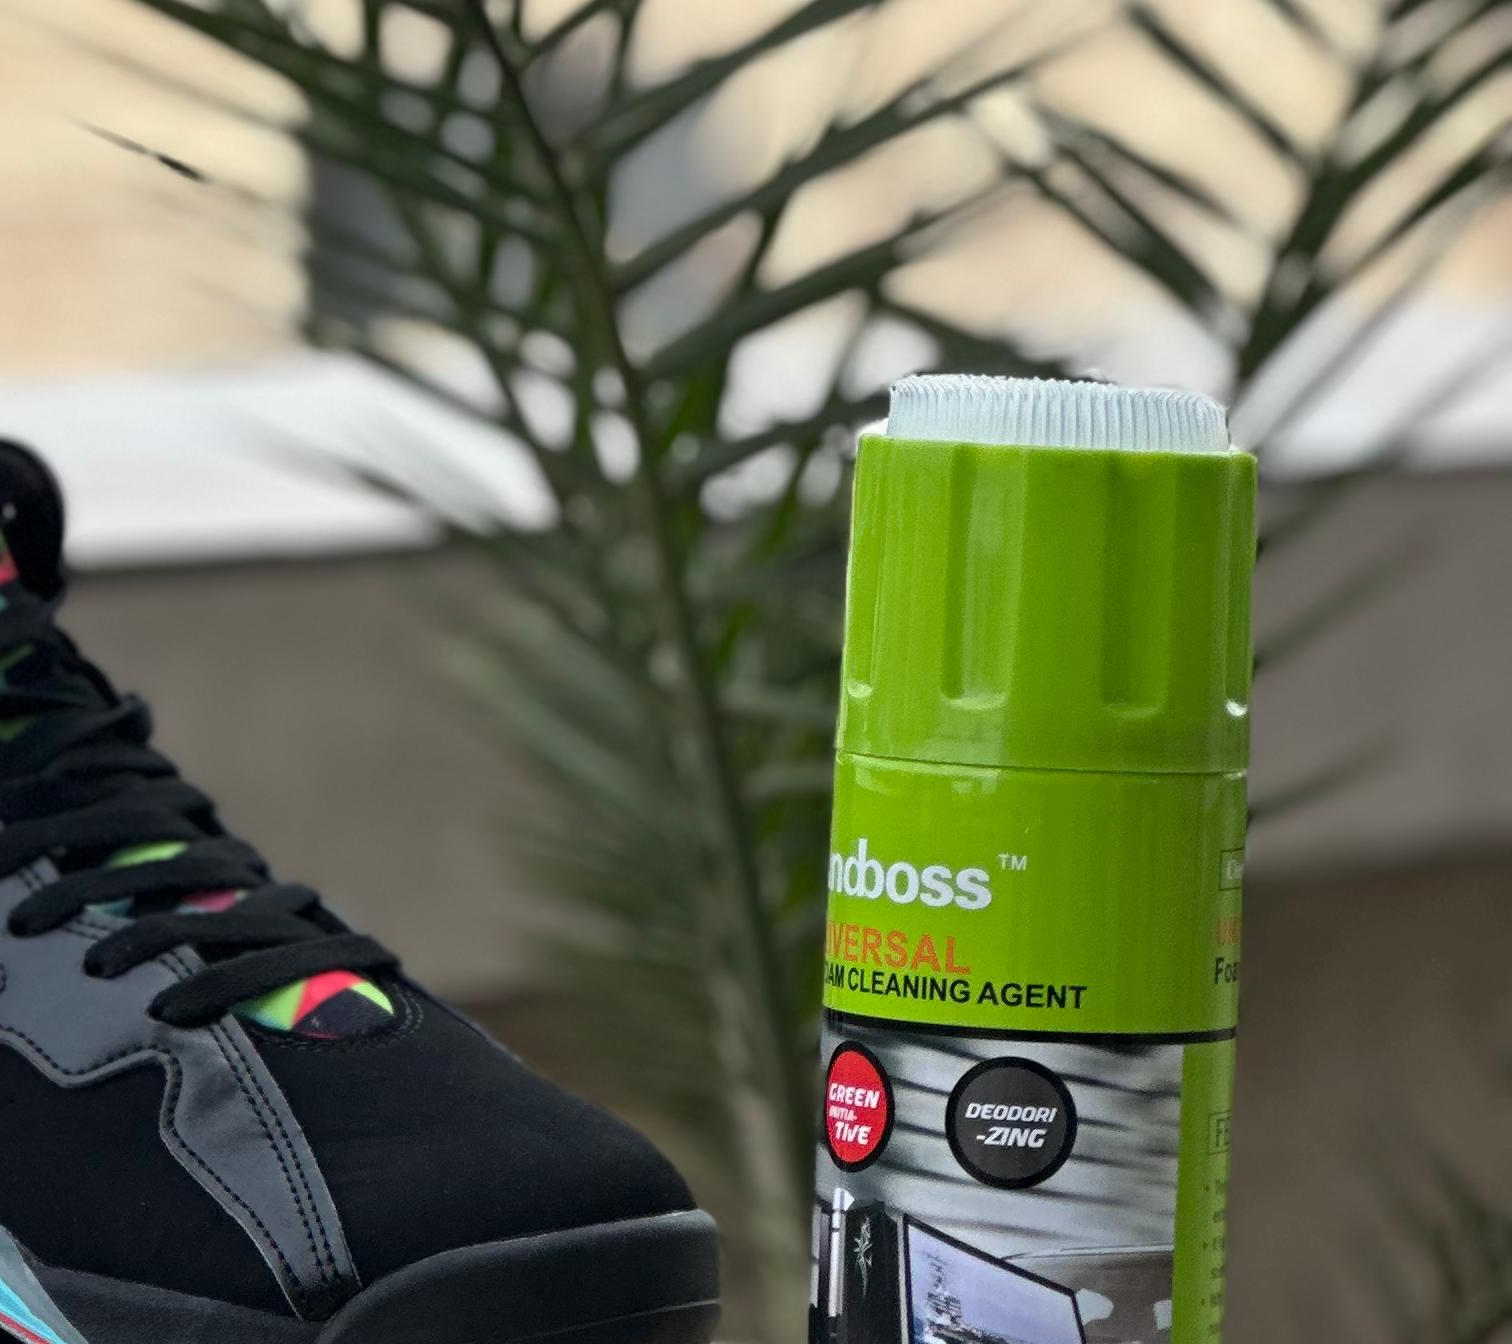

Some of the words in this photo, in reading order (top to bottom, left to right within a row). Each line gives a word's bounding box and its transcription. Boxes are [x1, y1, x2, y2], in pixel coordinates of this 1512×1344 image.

[848, 967, 970, 1003] CLEANING
[977, 980, 1088, 1009] AGENT
[829, 1083, 881, 1109] GREEN
[965, 1102, 1058, 1124] DEODORI
[835, 1121, 872, 1146] TIVE
[976, 1125, 1048, 1149] -ZING
